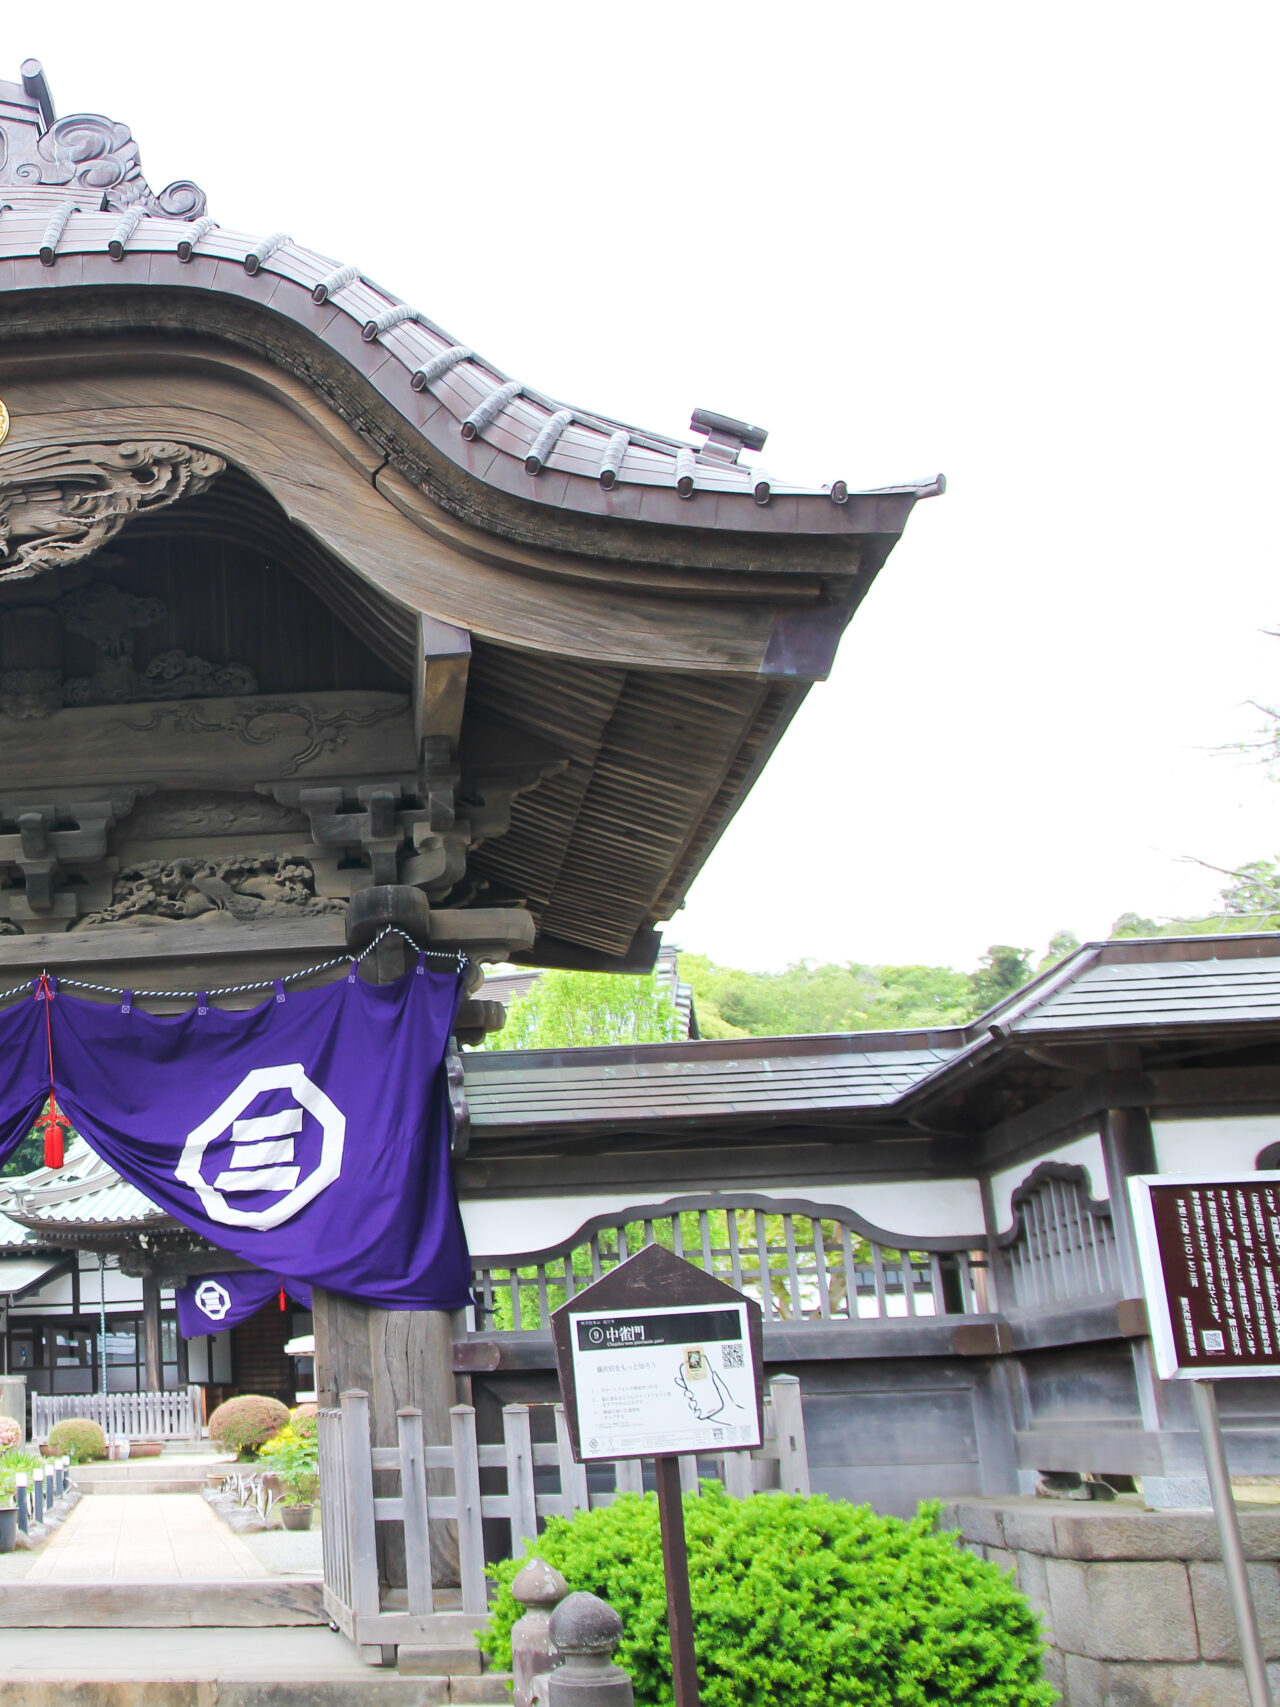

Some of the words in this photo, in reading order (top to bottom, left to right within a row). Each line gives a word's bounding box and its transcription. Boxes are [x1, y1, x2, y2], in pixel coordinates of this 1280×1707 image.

[606, 1325, 645, 1343] 中雀門
[1180, 1297, 1198, 1357] 藤沢市教育委員会
